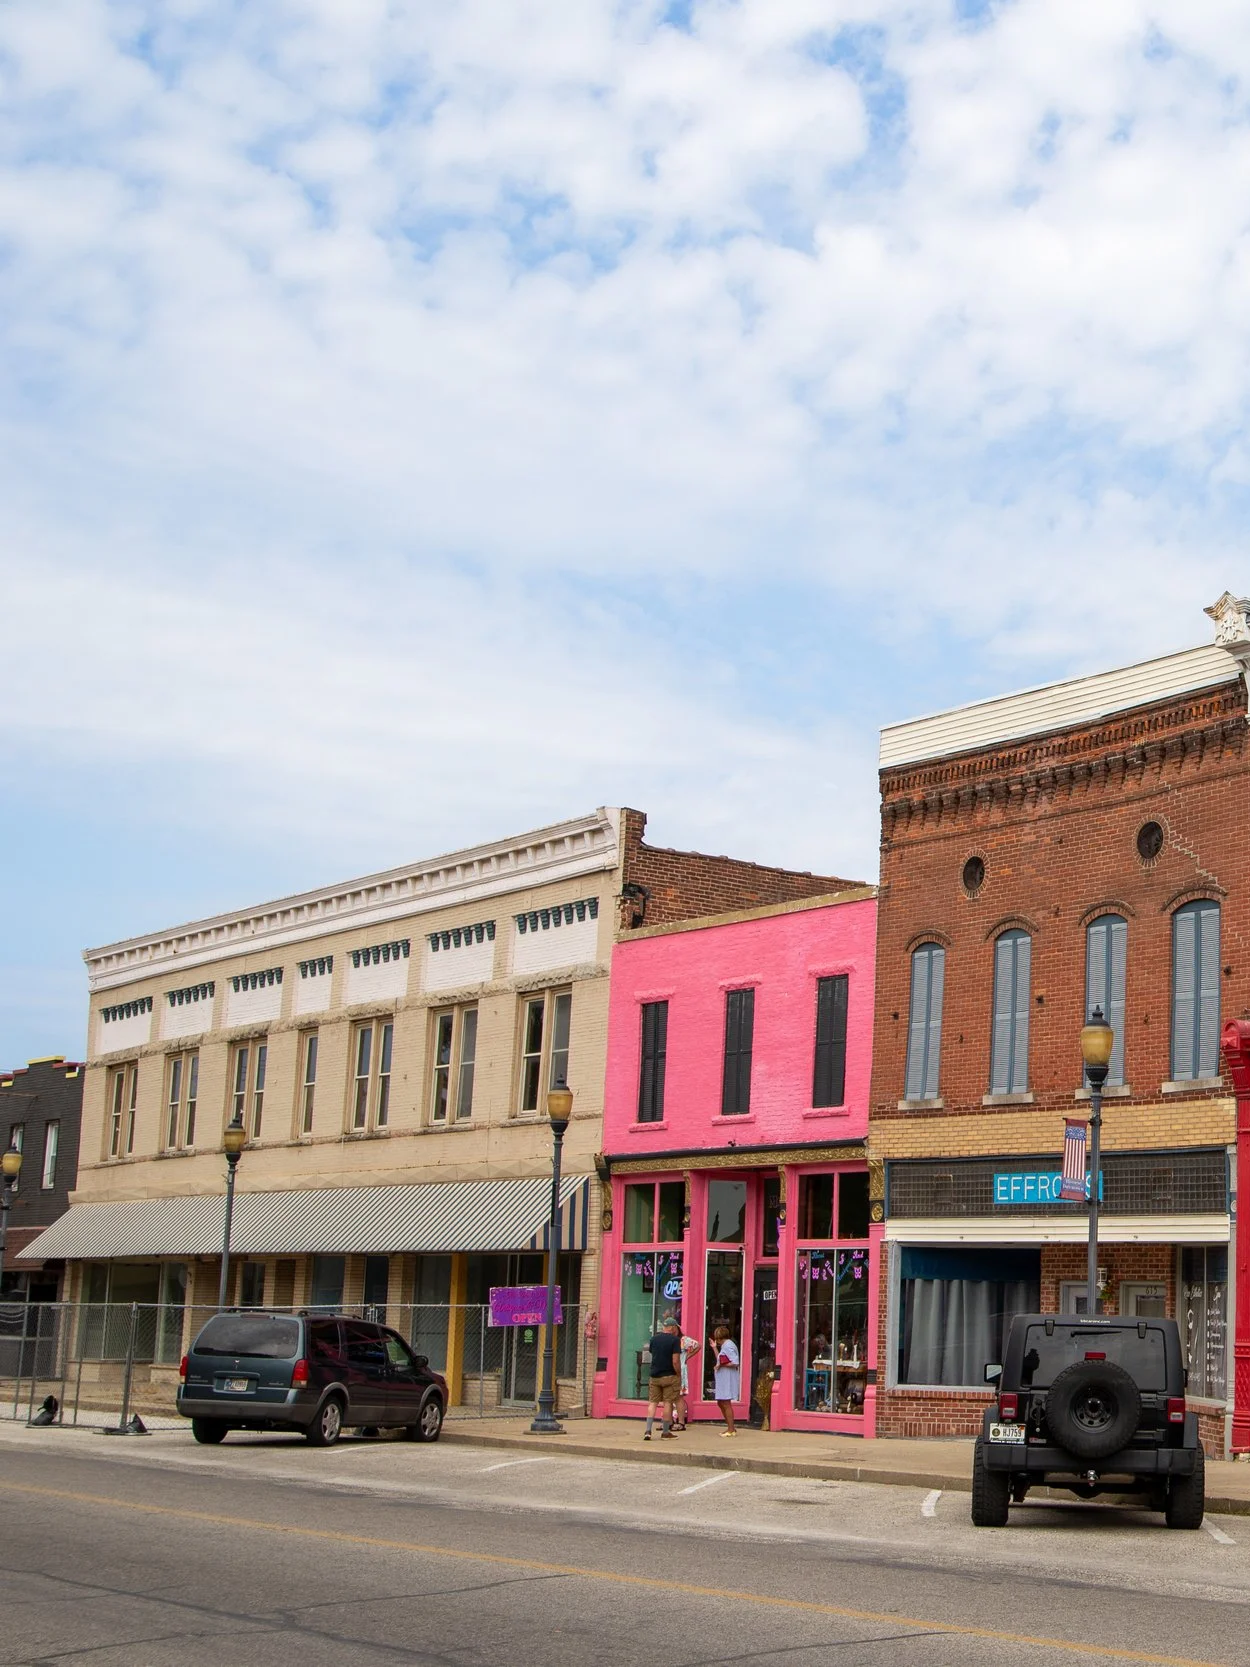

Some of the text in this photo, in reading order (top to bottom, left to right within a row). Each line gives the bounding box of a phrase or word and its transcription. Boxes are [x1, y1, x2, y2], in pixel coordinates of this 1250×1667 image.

[997, 1175, 1098, 1200] EFFROS
[665, 1280, 683, 1296] OPE
[1145, 1286, 1158, 1295] 615
[512, 1313, 543, 1323] OPEN
[1003, 1428, 1022, 1438] HJ759
